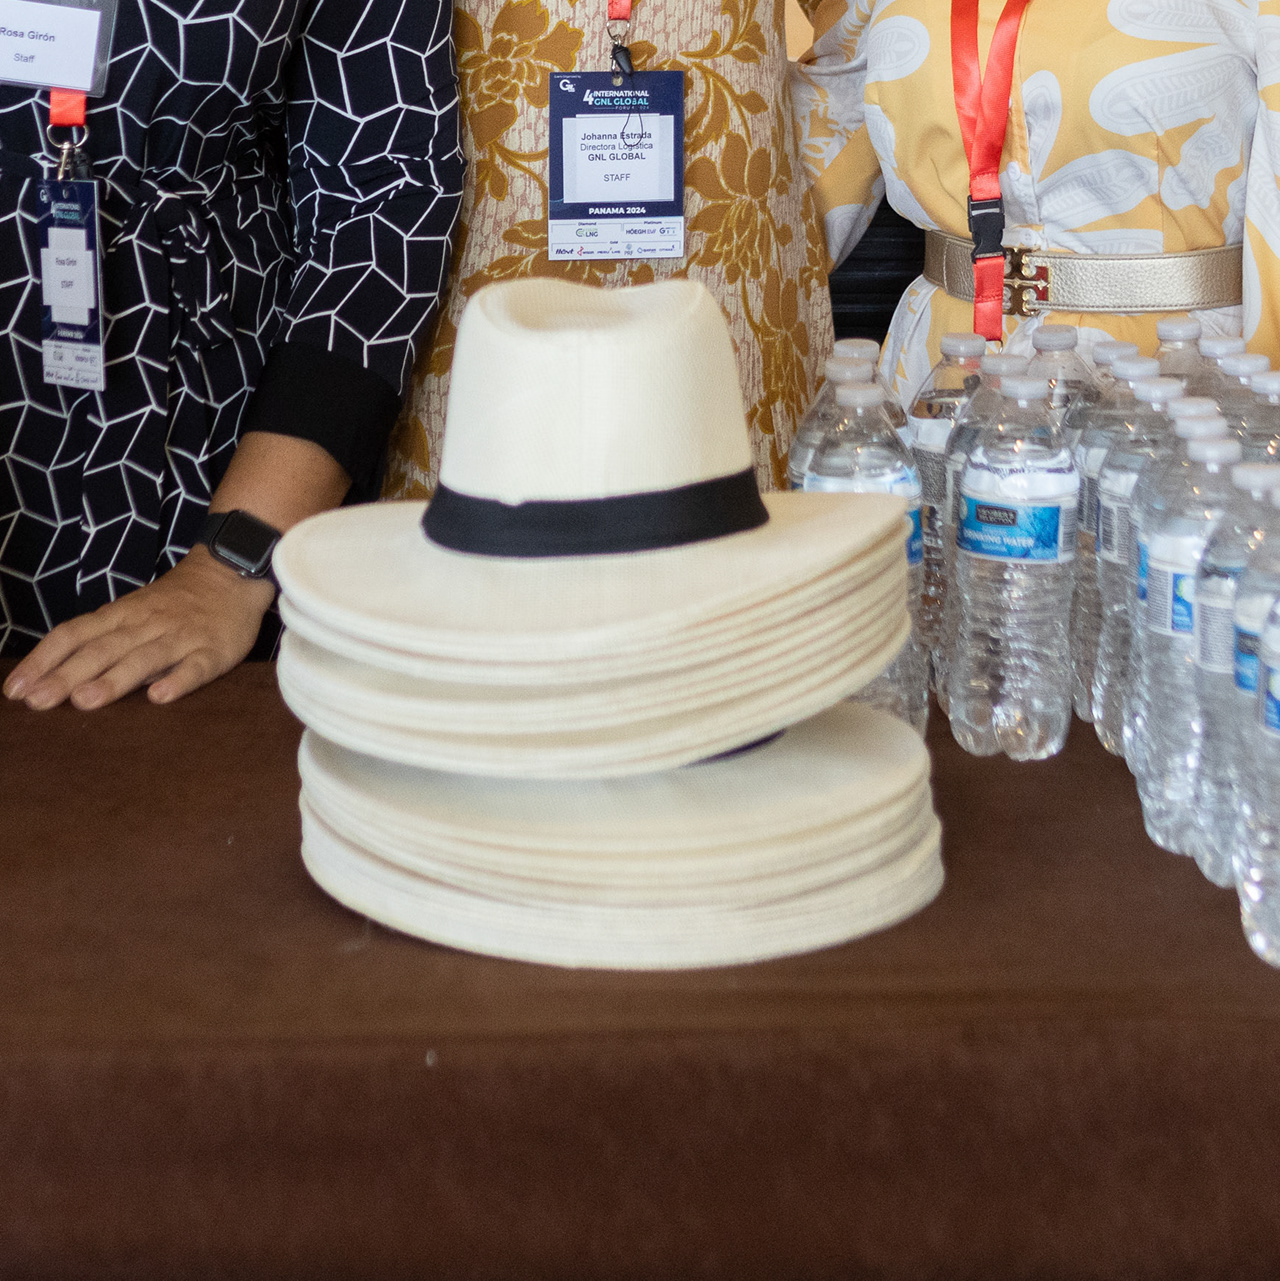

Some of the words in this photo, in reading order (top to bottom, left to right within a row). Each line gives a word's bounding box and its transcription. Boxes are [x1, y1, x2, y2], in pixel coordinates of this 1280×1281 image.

[13, 53, 35, 64] Staff
[583, 89, 594, 105] 4
[594, 98, 613, 106] GNL
[613, 98, 649, 106] GLOBAL
[581, 132, 618, 141] Johanna
[620, 131, 652, 140] Estrada
[580, 143, 616, 151] Directora
[588, 153, 607, 162] GNL
[609, 152, 646, 161] GLOBAL
[603, 173, 631, 182] STAFF
[588, 207, 625, 215] PANAMA
[626, 206, 646, 214] 2024
